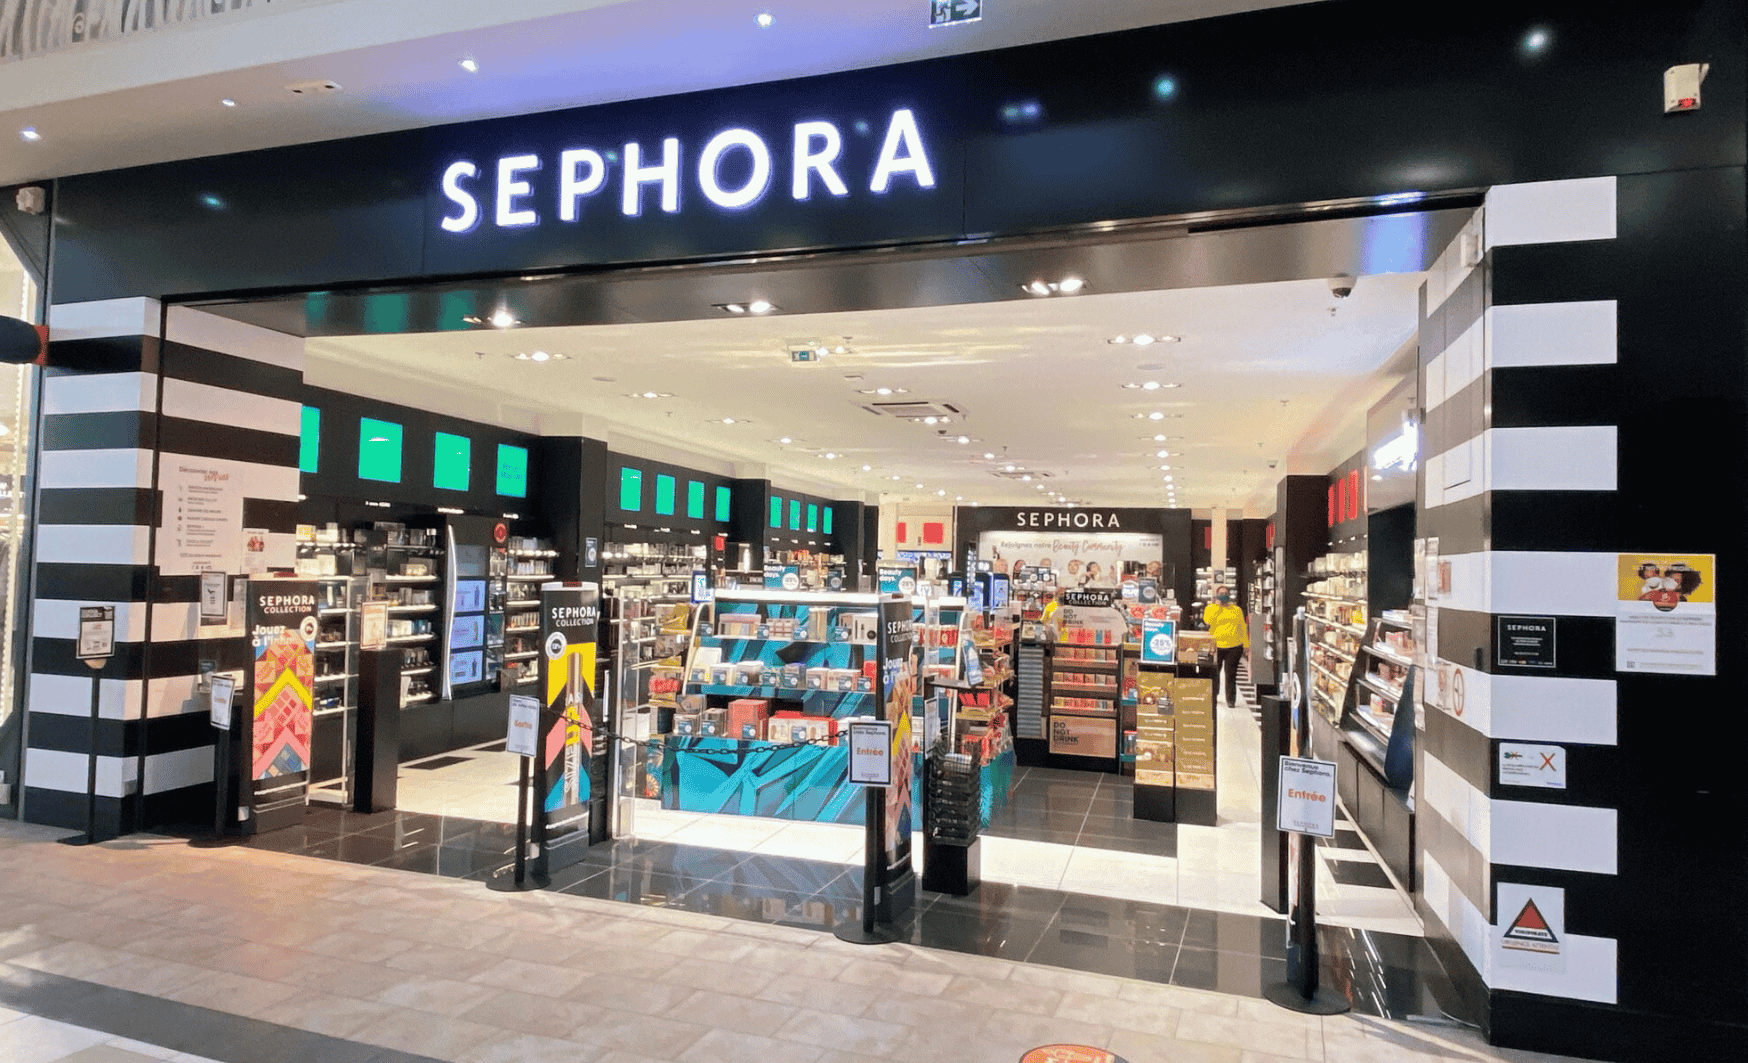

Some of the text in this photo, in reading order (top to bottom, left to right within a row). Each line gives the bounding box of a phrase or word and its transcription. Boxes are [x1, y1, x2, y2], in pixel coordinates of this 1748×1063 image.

[440, 107, 937, 234] SEPHORA
[1016, 511, 1121, 528] SEPHORA
[1000, 541, 1033, 550] Rejoignez
[1052, 539, 1080, 557] Beauty
[763, 564, 787, 573] Beauty
[879, 568, 903, 577] Beauty
[259, 594, 315, 607] SEPHORA
[1066, 592, 1110, 602] SEPHORA
[263, 605, 312, 614] COLLECTION
[551, 605, 596, 619] SEPHORA
[555, 617, 595, 628] COLLECTION
[251, 624, 287, 636] Jouez
[1507, 624, 1547, 632] SEPHORA
[1152, 638, 1171, 647] -25%
[1053, 721, 1066, 729] DO
[1053, 735, 1079, 743] DRINK
[856, 747, 884, 756] Entrée
[1284, 760, 1319, 770] Bienvenue
[1301, 767, 1332, 778] Sephora.
[1287, 788, 1327, 802] Entrée
